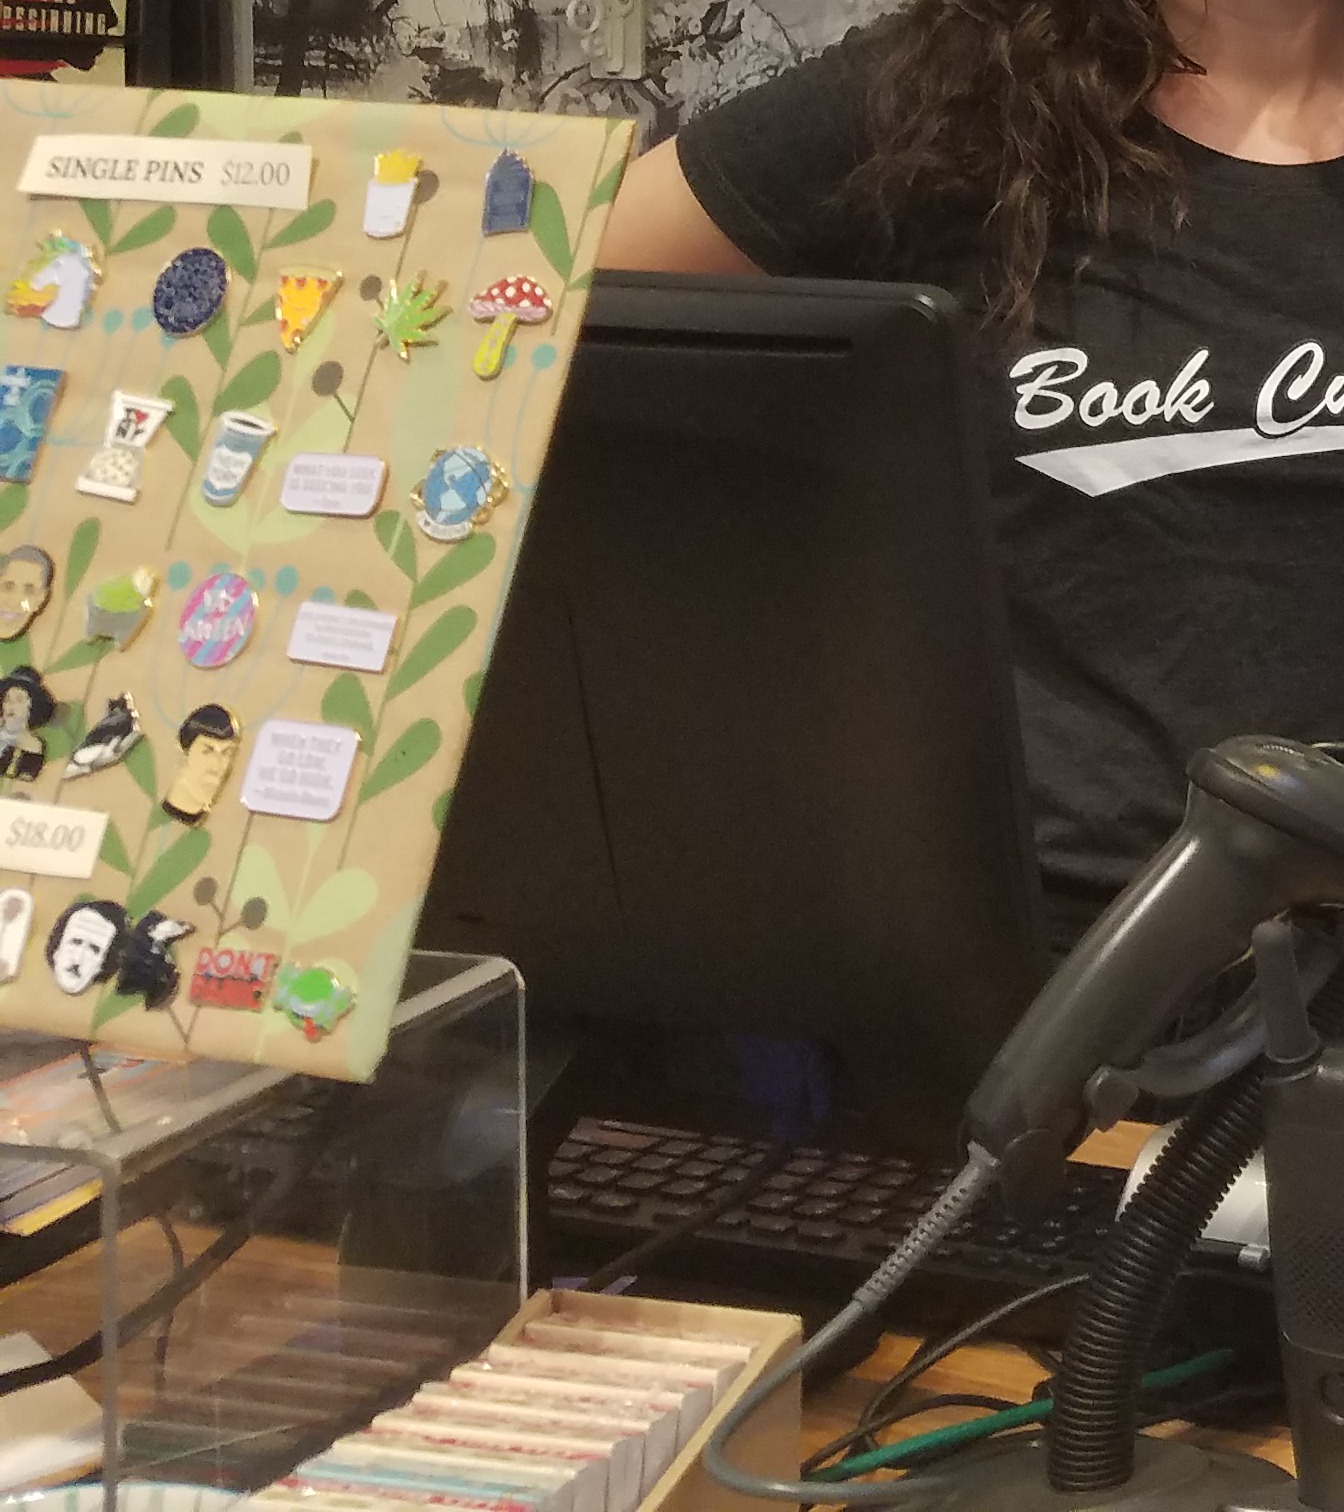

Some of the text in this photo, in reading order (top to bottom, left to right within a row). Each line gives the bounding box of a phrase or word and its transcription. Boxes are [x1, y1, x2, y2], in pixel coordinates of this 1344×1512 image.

[46, 156, 291, 187] SINGLE PINS $12.00
[1009, 346, 1215, 430] Book
[7, 819, 85, 851] $18.00
